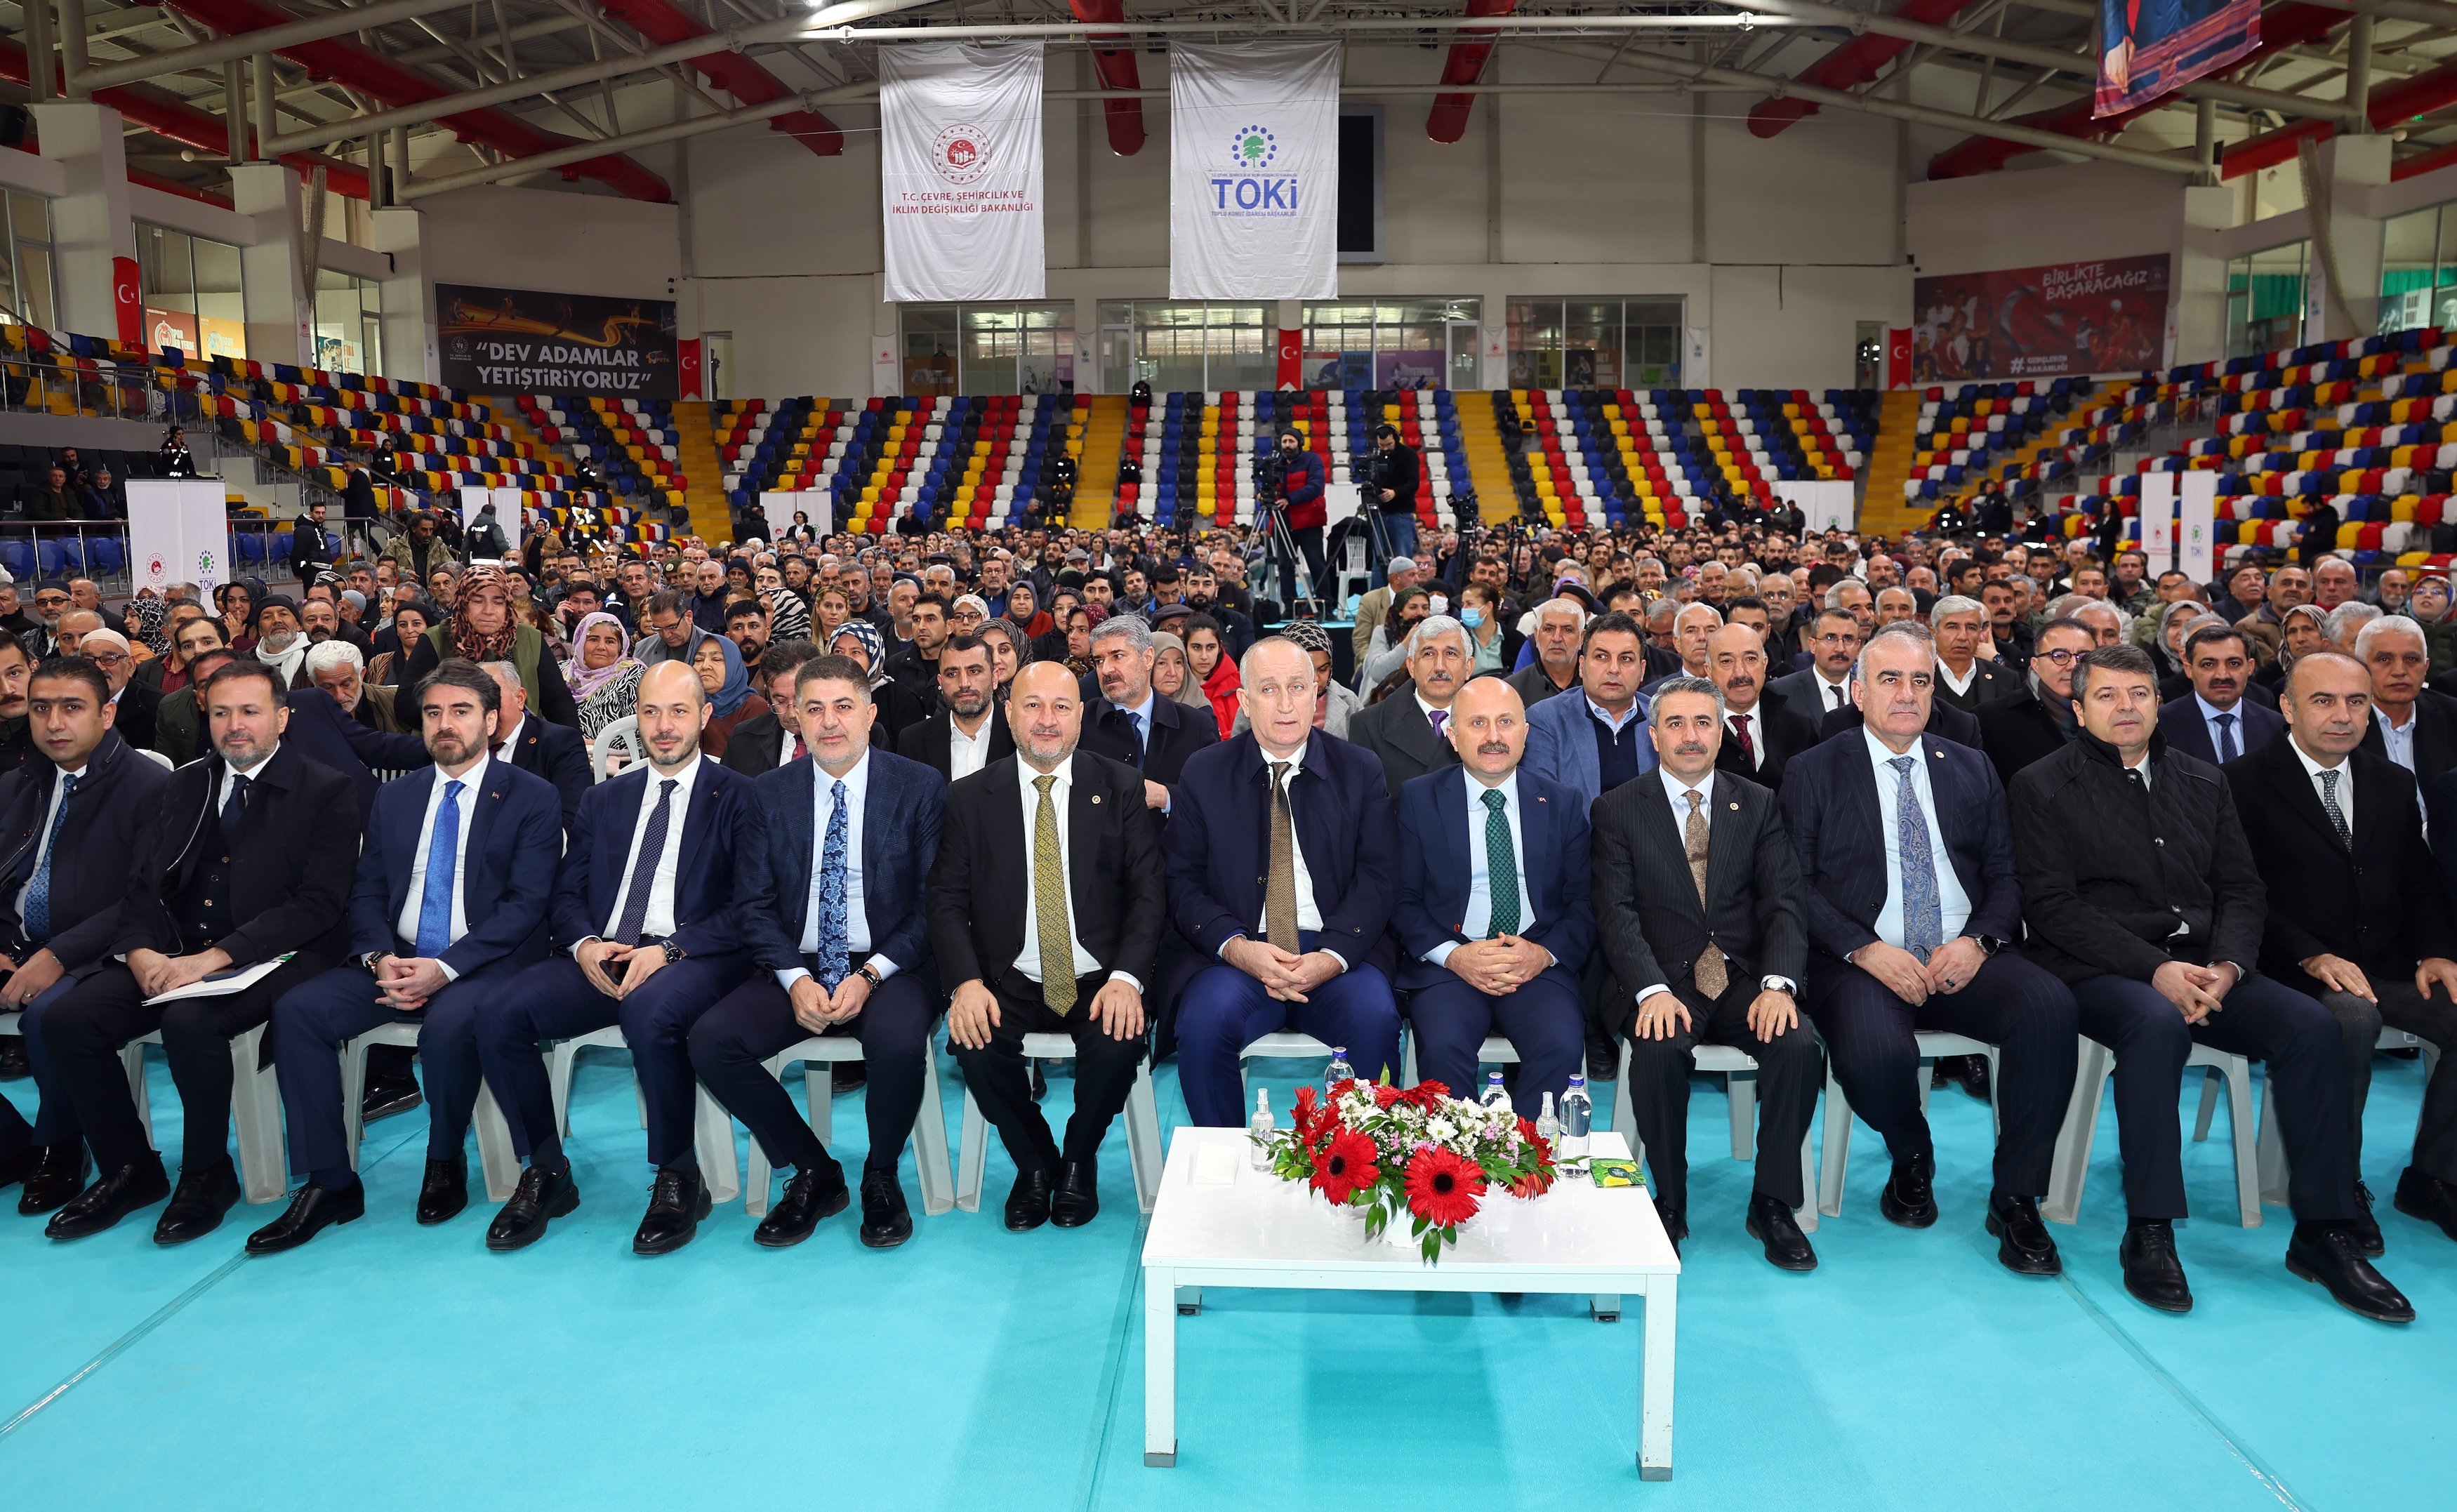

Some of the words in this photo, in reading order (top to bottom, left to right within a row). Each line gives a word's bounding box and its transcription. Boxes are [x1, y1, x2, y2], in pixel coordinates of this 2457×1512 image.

[921, 192, 954, 203] ÇEVRE,
[956, 190, 1009, 202] ŞEHİRCİLİK
[893, 204, 919, 214] İKLİM
[921, 202, 978, 215] DEĞİŞİKLİĞİ
[981, 201, 1033, 212] BAKANLIĞI
[2043, 263, 2105, 286] BİRLİKTE
[2046, 271, 2148, 300] BAŞARACAĞIZ
[538, 345, 640, 367] ADAMLAR
